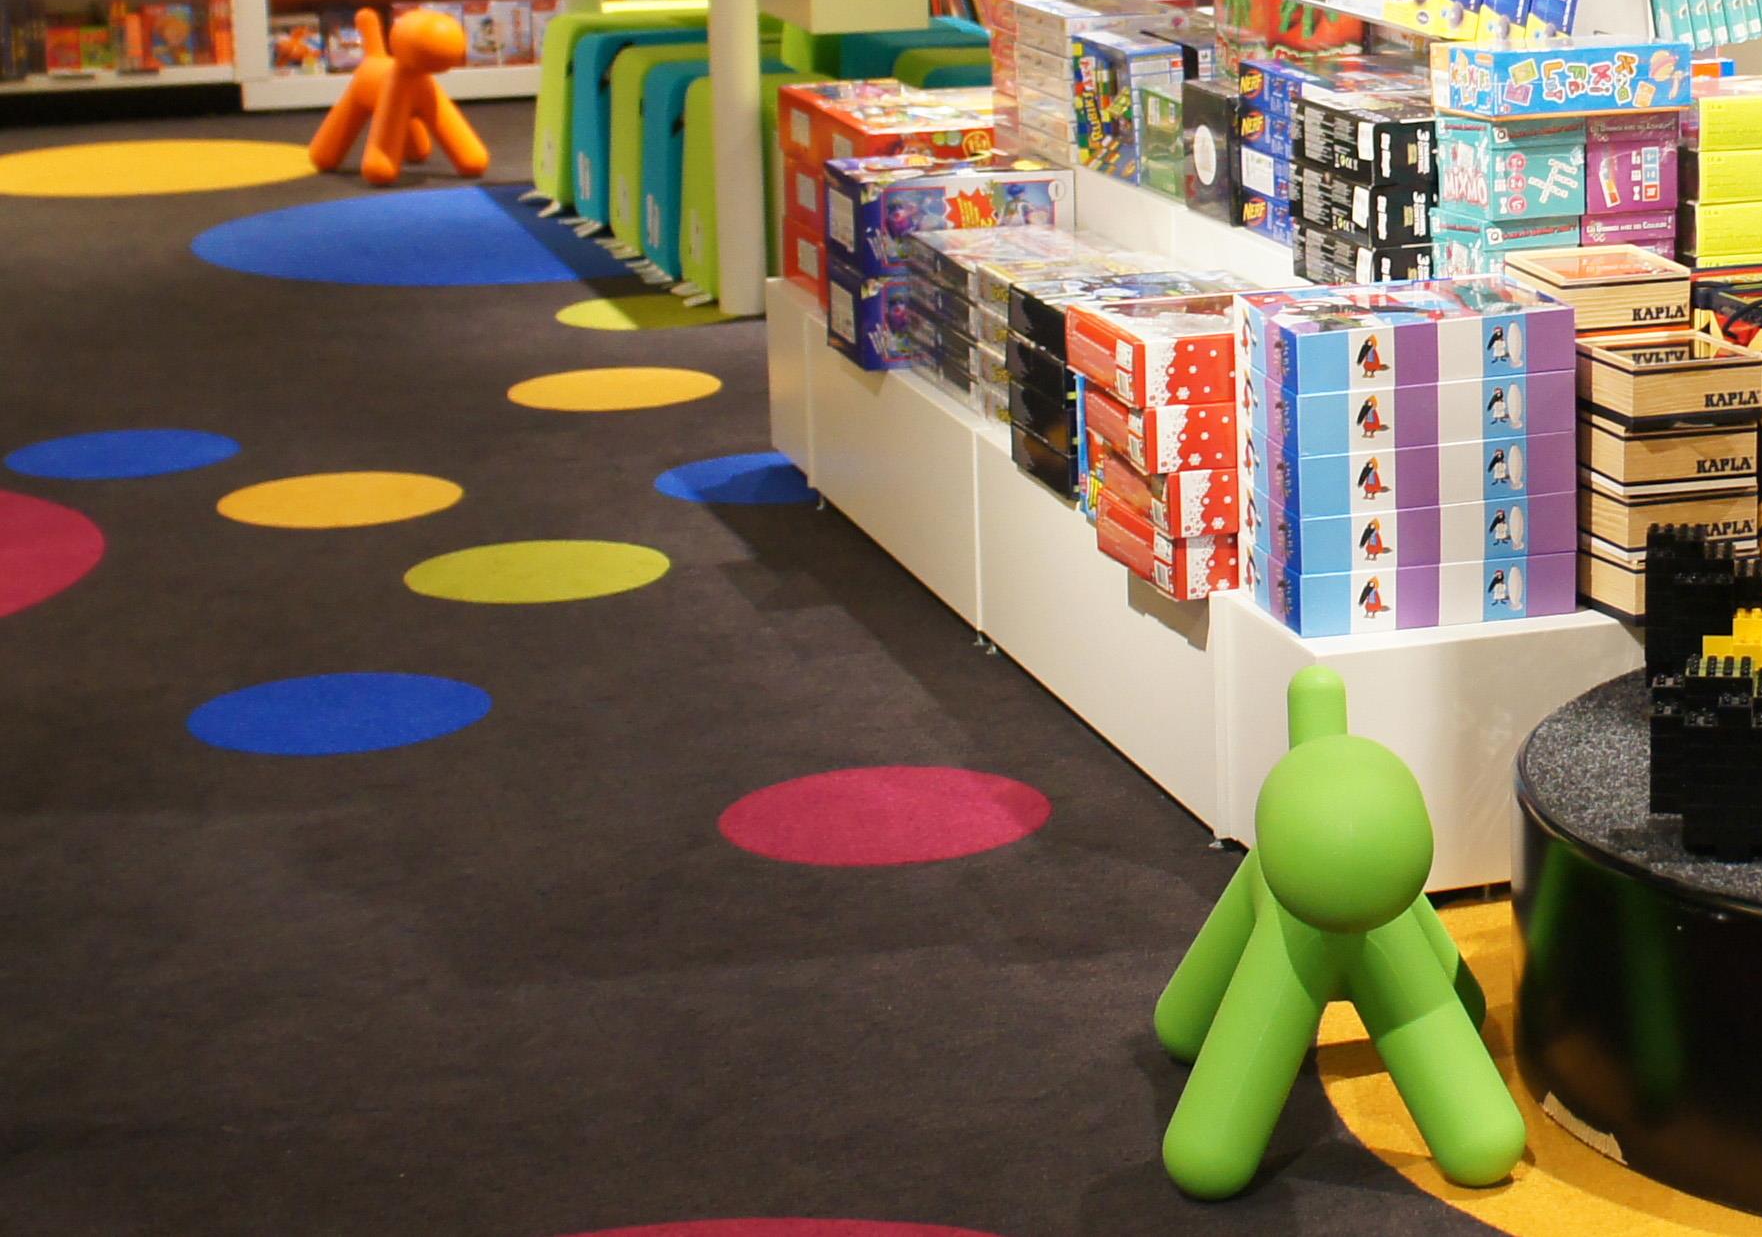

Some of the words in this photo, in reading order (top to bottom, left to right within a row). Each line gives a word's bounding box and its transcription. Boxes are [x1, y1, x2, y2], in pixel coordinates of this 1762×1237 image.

[1239, 75, 1264, 96] NERF
[1241, 116, 1264, 137] NERF
[1243, 202, 1266, 222] NERF
[1632, 305, 1687, 322] KAPLA
[1704, 390, 1760, 408] KAPLA
[1696, 456, 1753, 474] KAPLA
